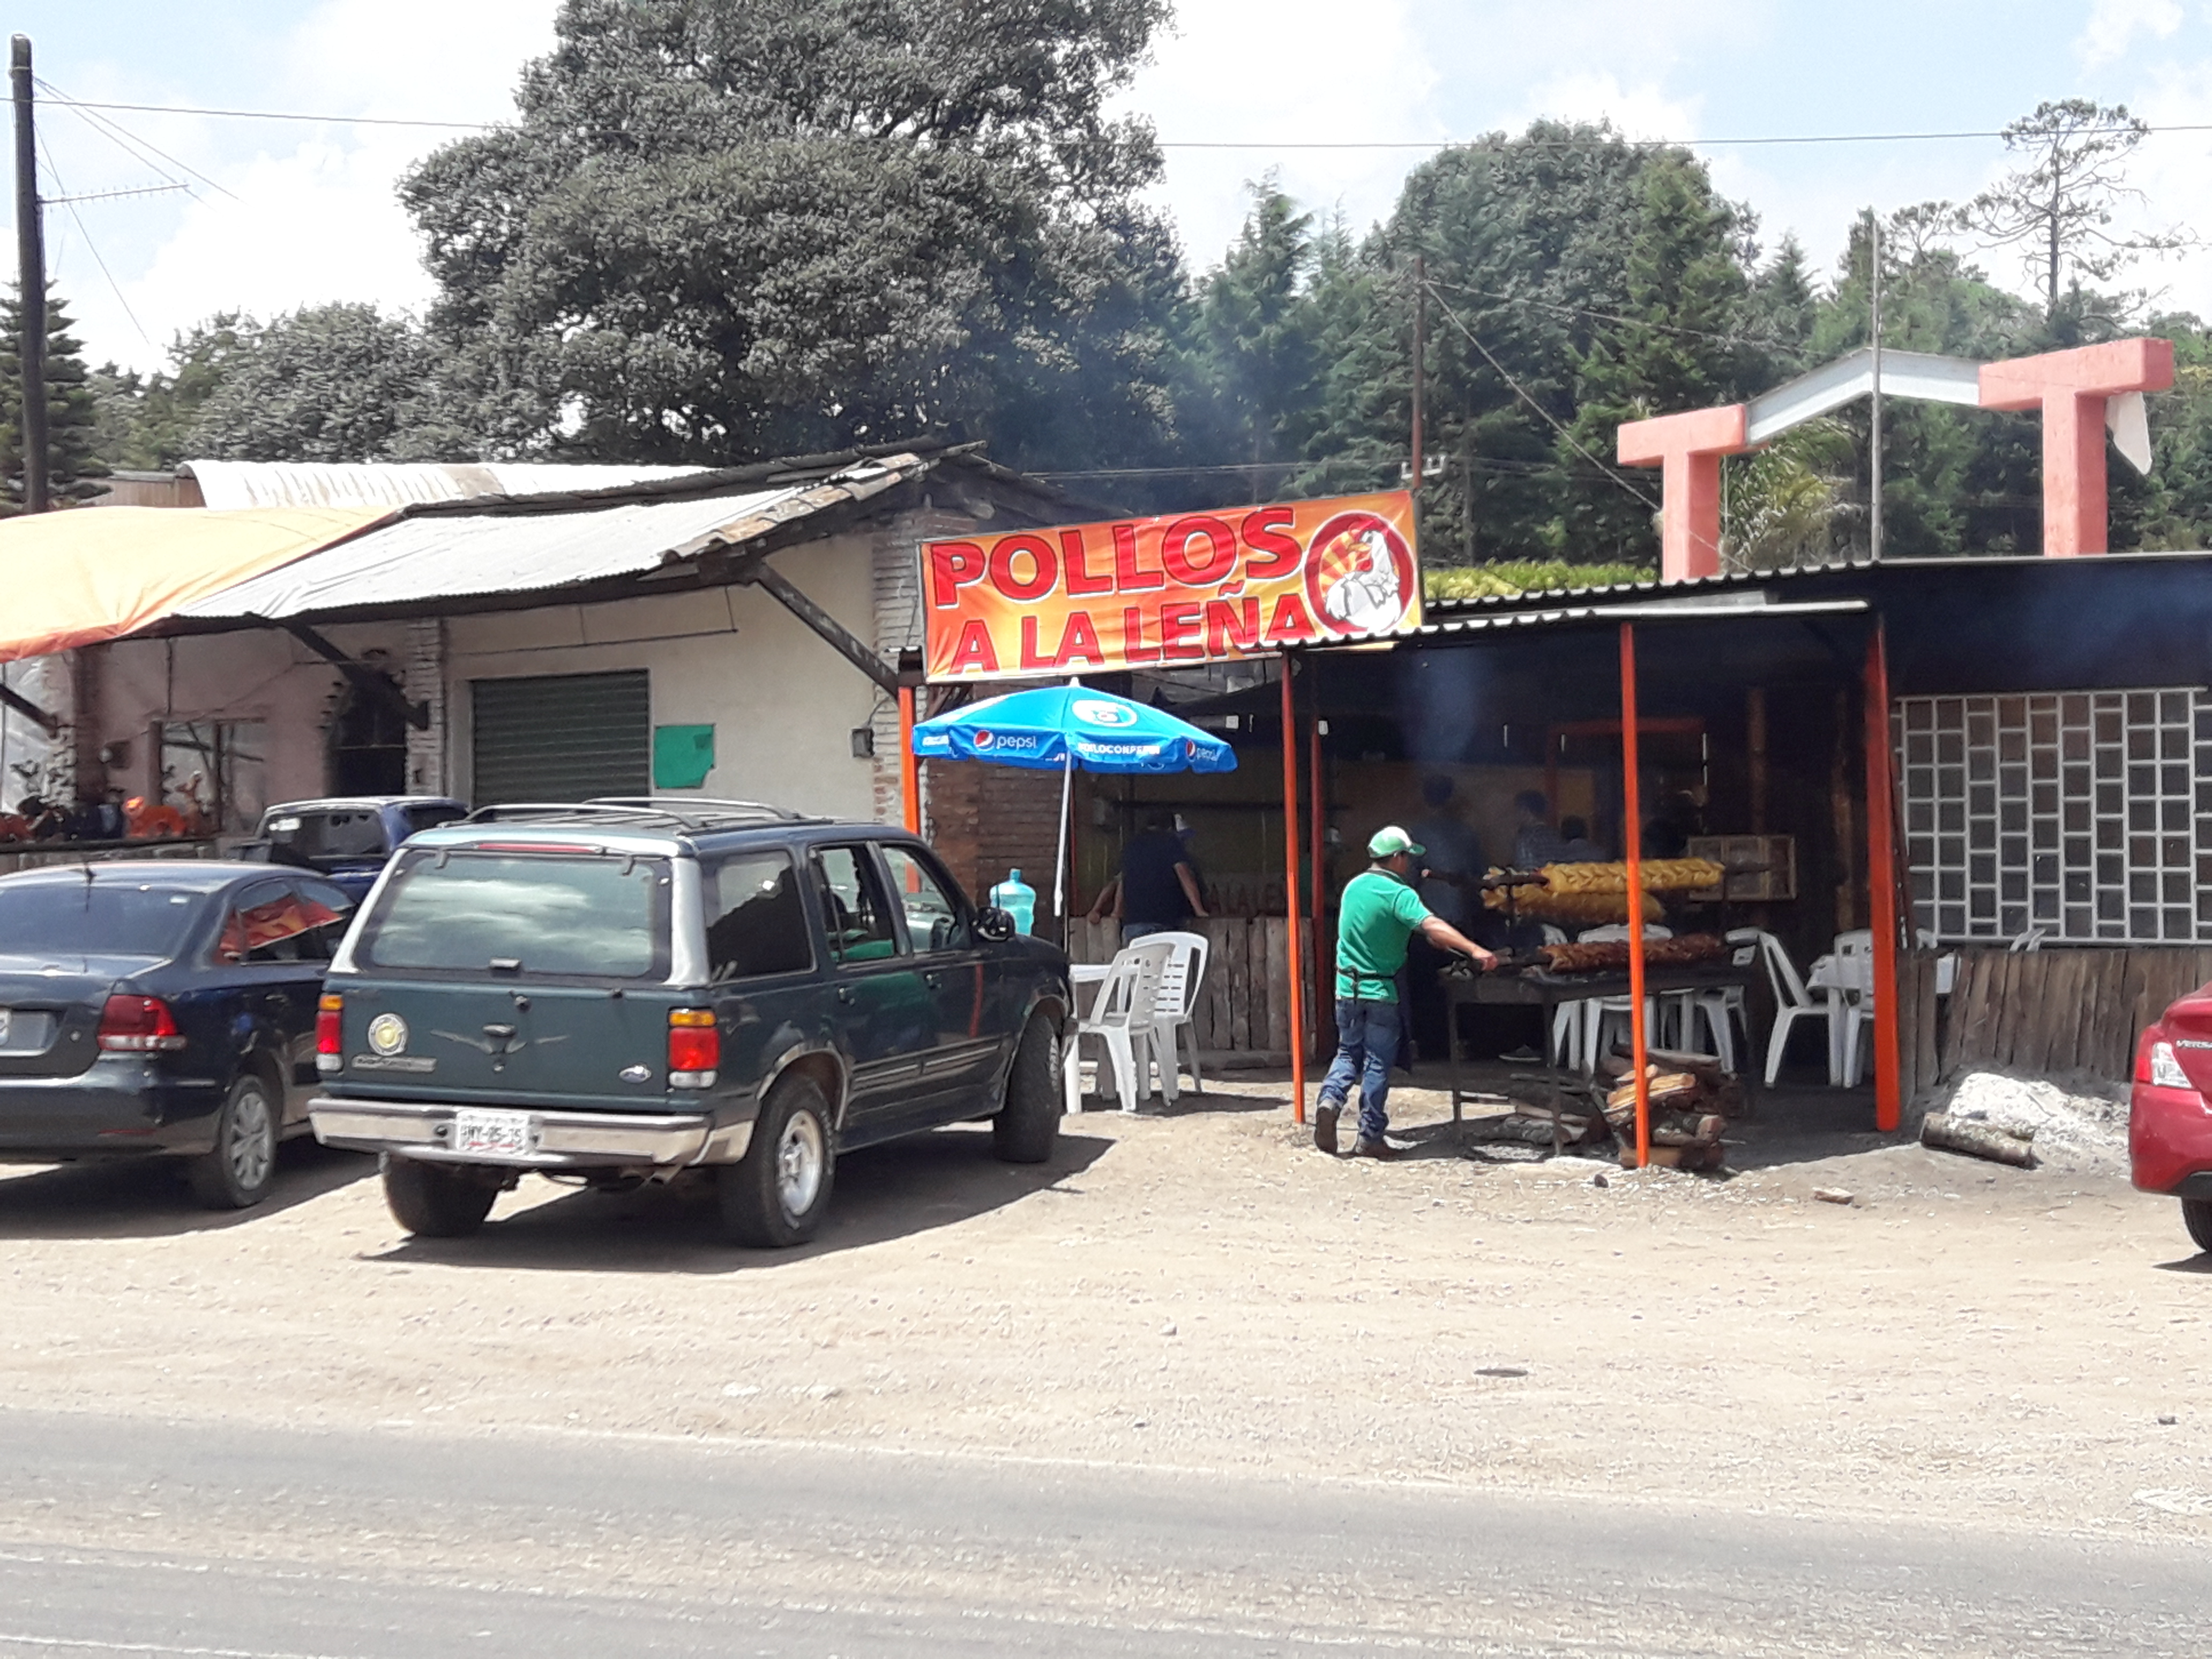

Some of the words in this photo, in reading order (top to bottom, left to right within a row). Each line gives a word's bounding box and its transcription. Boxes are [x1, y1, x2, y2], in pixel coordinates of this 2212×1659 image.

[931, 506, 1303, 608] POLLOS
[948, 619, 1000, 675] A
[1020, 611, 1105, 670] LA
[1124, 580, 1316, 664] LEÑA
[996, 735, 1037, 751] pepsi
